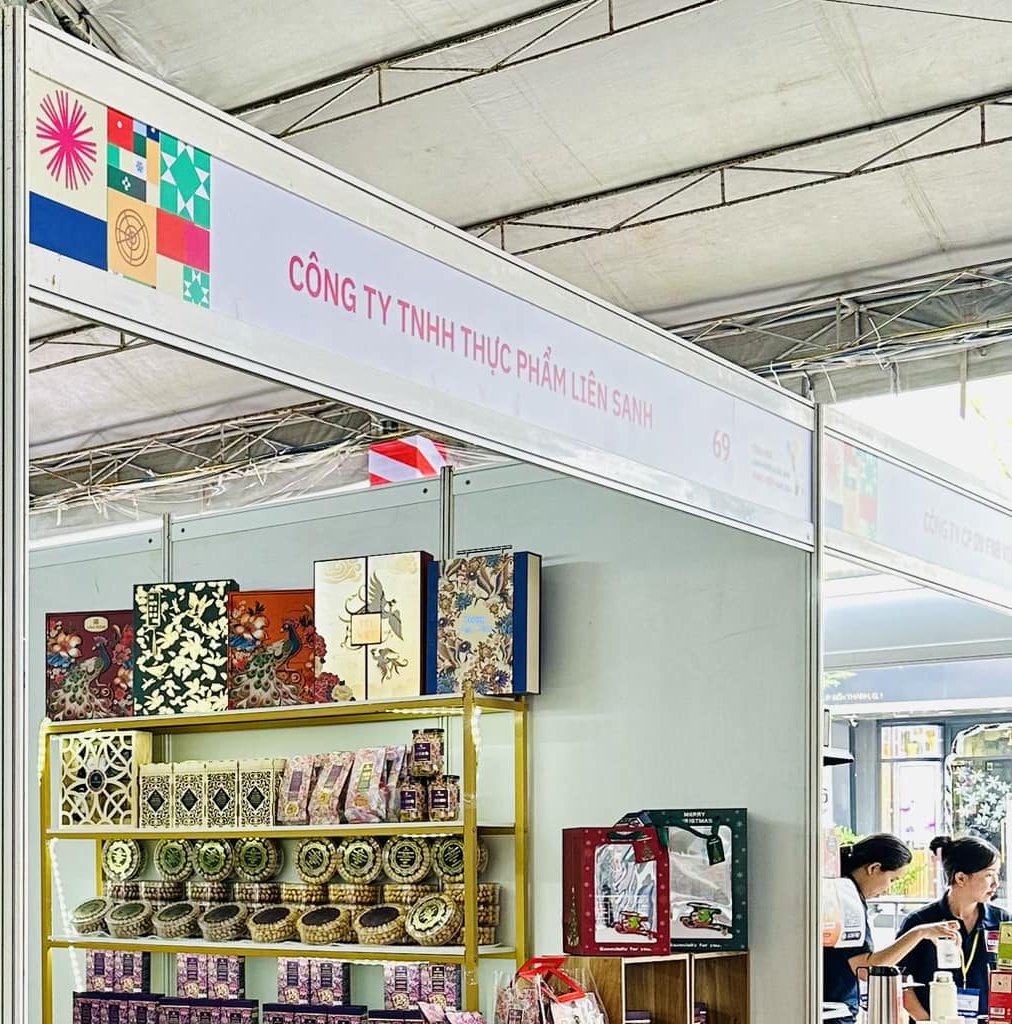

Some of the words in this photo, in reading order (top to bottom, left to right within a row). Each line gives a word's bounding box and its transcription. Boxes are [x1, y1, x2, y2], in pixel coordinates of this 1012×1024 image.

[288, 251, 357, 313] CÔNG
[363, 284, 393, 325] TY
[397, 299, 455, 352] TNHH
[461, 325, 512, 376] THỰC
[516, 345, 567, 396] PHẨM
[571, 370, 608, 412] LIÊN
[612, 389, 653, 429] SANH
[712, 430, 731, 462] 69
